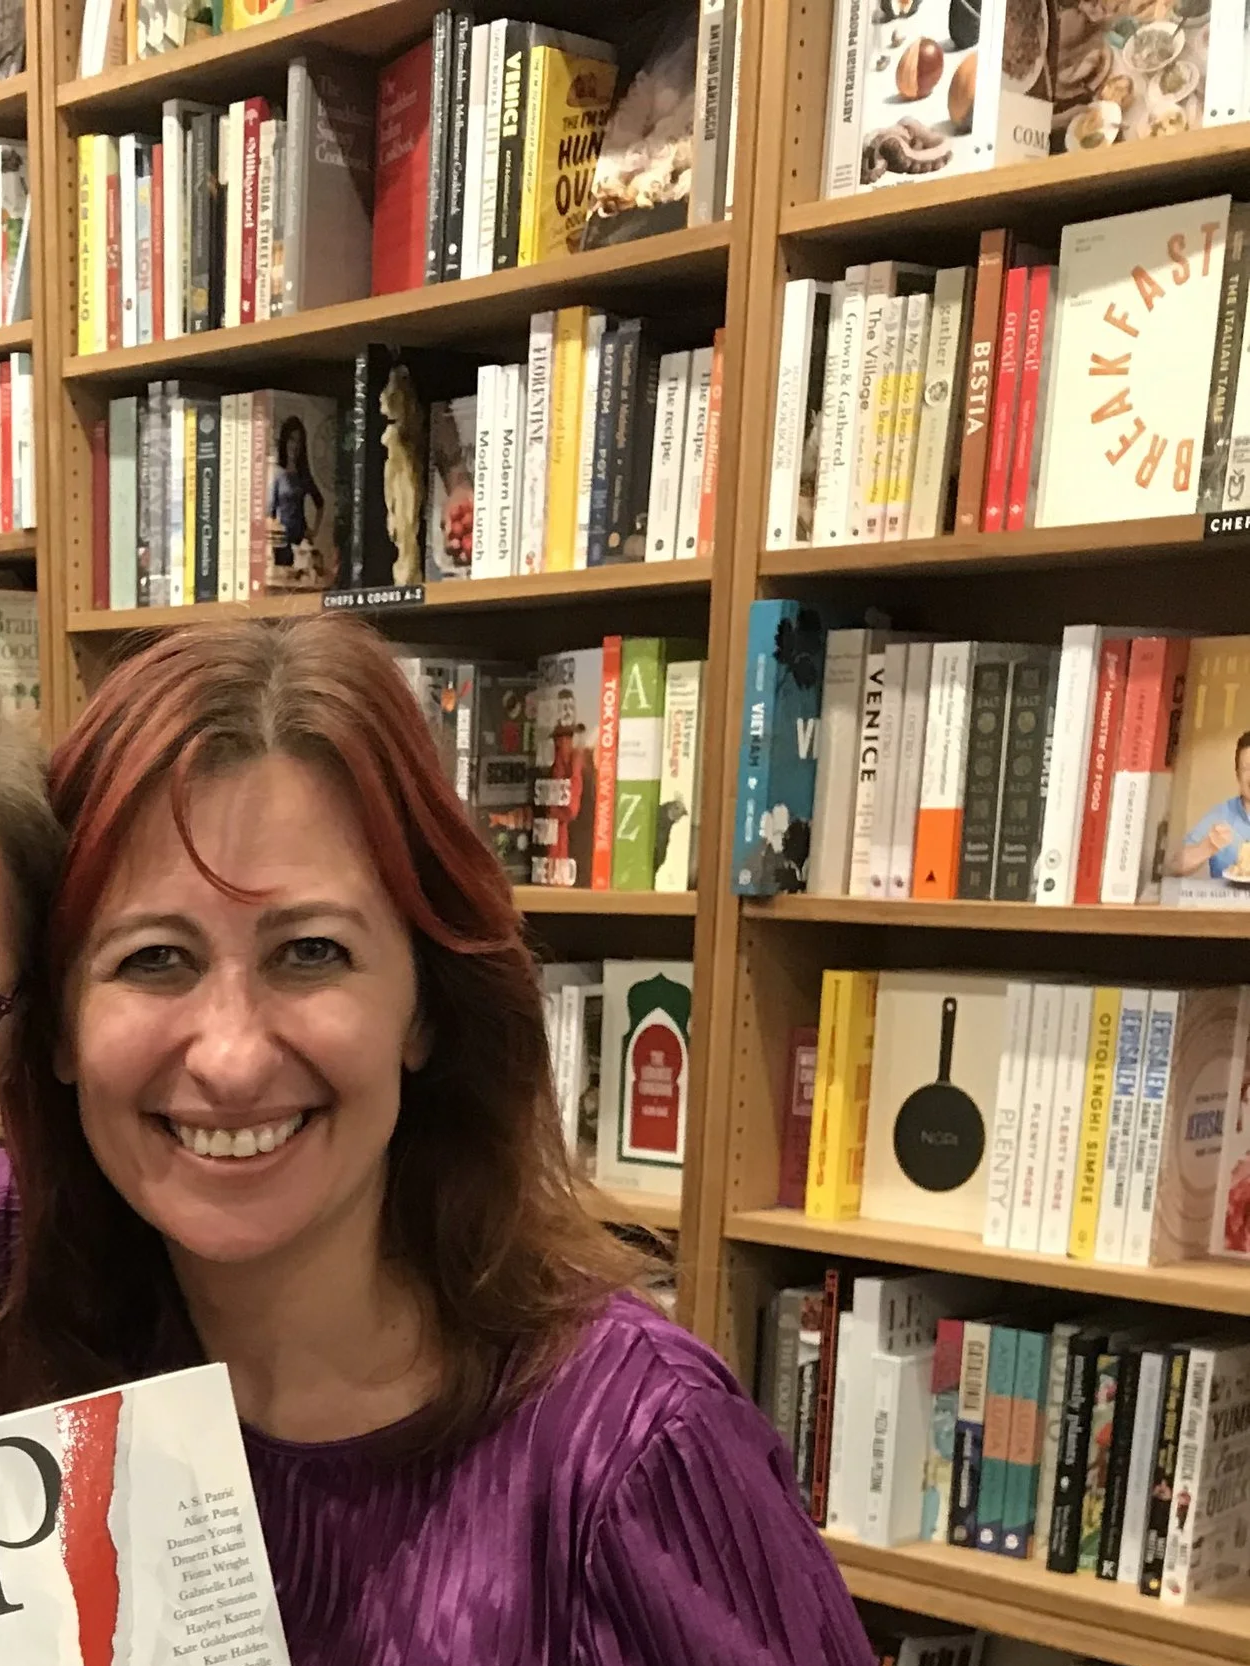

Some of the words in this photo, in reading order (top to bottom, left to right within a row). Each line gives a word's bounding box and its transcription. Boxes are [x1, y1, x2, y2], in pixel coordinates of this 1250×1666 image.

[502, 51, 522, 137] VENICE
[557, 131, 606, 170] HUN
[260, 176, 271, 213] CUBA
[258, 218, 270, 269] STREET
[842, 312, 857, 371] Grown
[866, 308, 882, 341] The
[884, 336, 896, 358] My
[905, 332, 919, 356] My
[936, 304, 952, 369] gather
[1001, 312, 1017, 373] orexi!
[1023, 309, 1042, 372] orexi!
[600, 343, 614, 414] BOTTOM
[843, 373, 852, 388] &
[902, 358, 918, 405] Smoko
[1088, 221, 1222, 492] BREAKFAST
[529, 346, 547, 446] FLORENTINE
[665, 376, 678, 408] The
[879, 362, 895, 407] Smoko
[966, 341, 992, 436] BESTIA
[661, 411, 676, 467] recipe.
[775, 379, 790, 470] COOKBOOK
[875, 409, 890, 451] Break
[898, 407, 912, 446] Break
[475, 431, 490, 501] Modern
[501, 429, 513, 500] Modern
[596, 448, 607, 480] POT
[200, 467, 213, 524] Country
[201, 524, 212, 577] Classics
[474, 507, 487, 561] Lunch
[498, 505, 510, 560] Lunch
[1210, 517, 1250, 533] CHEF
[324, 592, 354, 607] CHEFS
[357, 593, 364, 605] &
[367, 589, 402, 604] COOKS
[622, 663, 651, 710] A
[600, 680, 616, 749] TOKYO
[684, 708, 696, 760] River
[749, 702, 765, 768] VIETNAM
[860, 667, 884, 783] VENICE
[669, 709, 683, 778] Cottage
[616, 793, 643, 841] Z
[1088, 1012, 1111, 1132] OTTOLENGHI
[1027, 1102, 1042, 1161] PLENTY
[1058, 1105, 1072, 1163] PLENTY
[989, 1108, 1016, 1210] PLENTY
[1080, 1140, 1098, 1206] SIMPLE
[1021, 1165, 1035, 1208] MORE
[1051, 1168, 1065, 1211] MORE
[166, 1533, 206, 1550] Damon
[208, 1523, 243, 1539] Young
[183, 1513, 209, 1528] Alice
[212, 1506, 239, 1520] Pung
[172, 1551, 209, 1567] Dmetri
[211, 1538, 246, 1557] Kakmi
[182, 1568, 211, 1583] Fiona
[213, 1556, 250, 1573] Wright
[178, 1581, 225, 1601] Gabrielle
[228, 1571, 254, 1588] Lord
[173, 1603, 214, 1621] Graeme
[186, 1618, 221, 1636] Hayley
[172, 1643, 197, 1657] Kate
[200, 1624, 265, 1649] Goldsworthy
[203, 1652, 228, 1666] Kate
[230, 1642, 269, 1659] Holden
